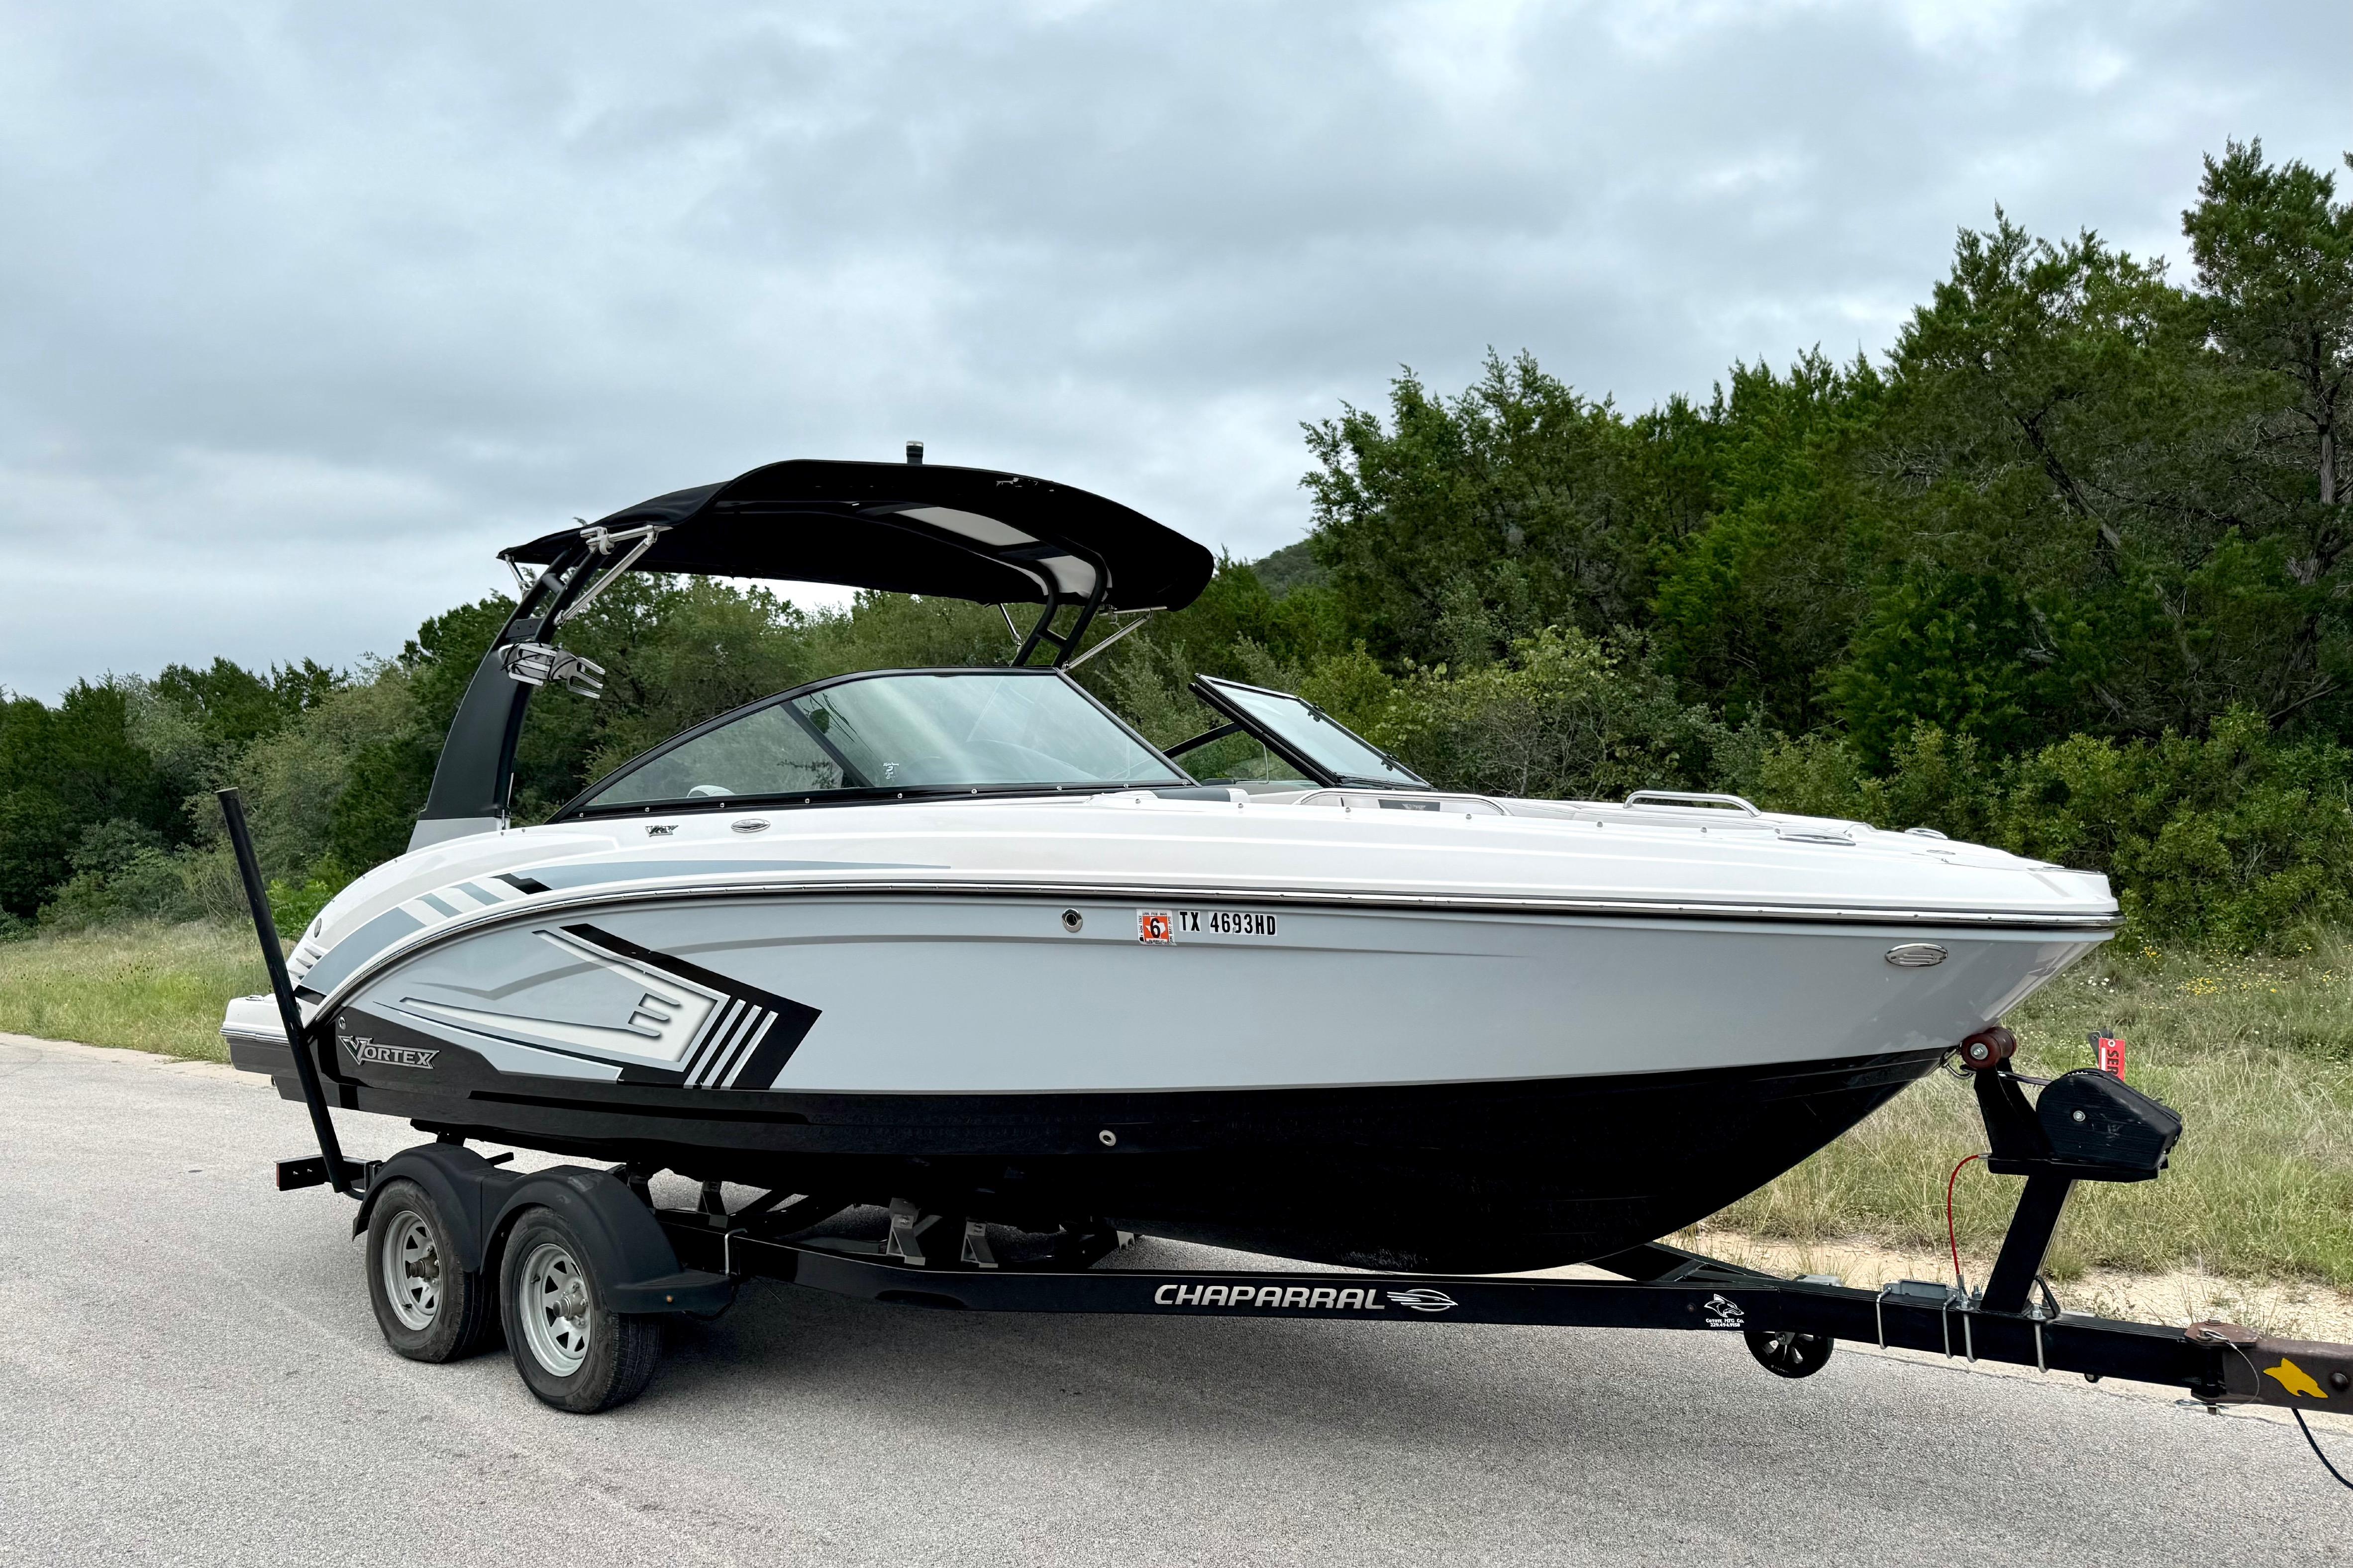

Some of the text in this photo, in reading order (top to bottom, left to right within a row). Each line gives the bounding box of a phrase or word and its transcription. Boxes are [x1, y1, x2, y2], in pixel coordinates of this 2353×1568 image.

[1150, 918, 1161, 939] 6
[1180, 911, 1200, 932] TX
[1210, 912, 1276, 935] 4693HD
[338, 1035, 432, 1066] VORTEX
[1154, 1284, 1385, 1309] CHAPARRAL
